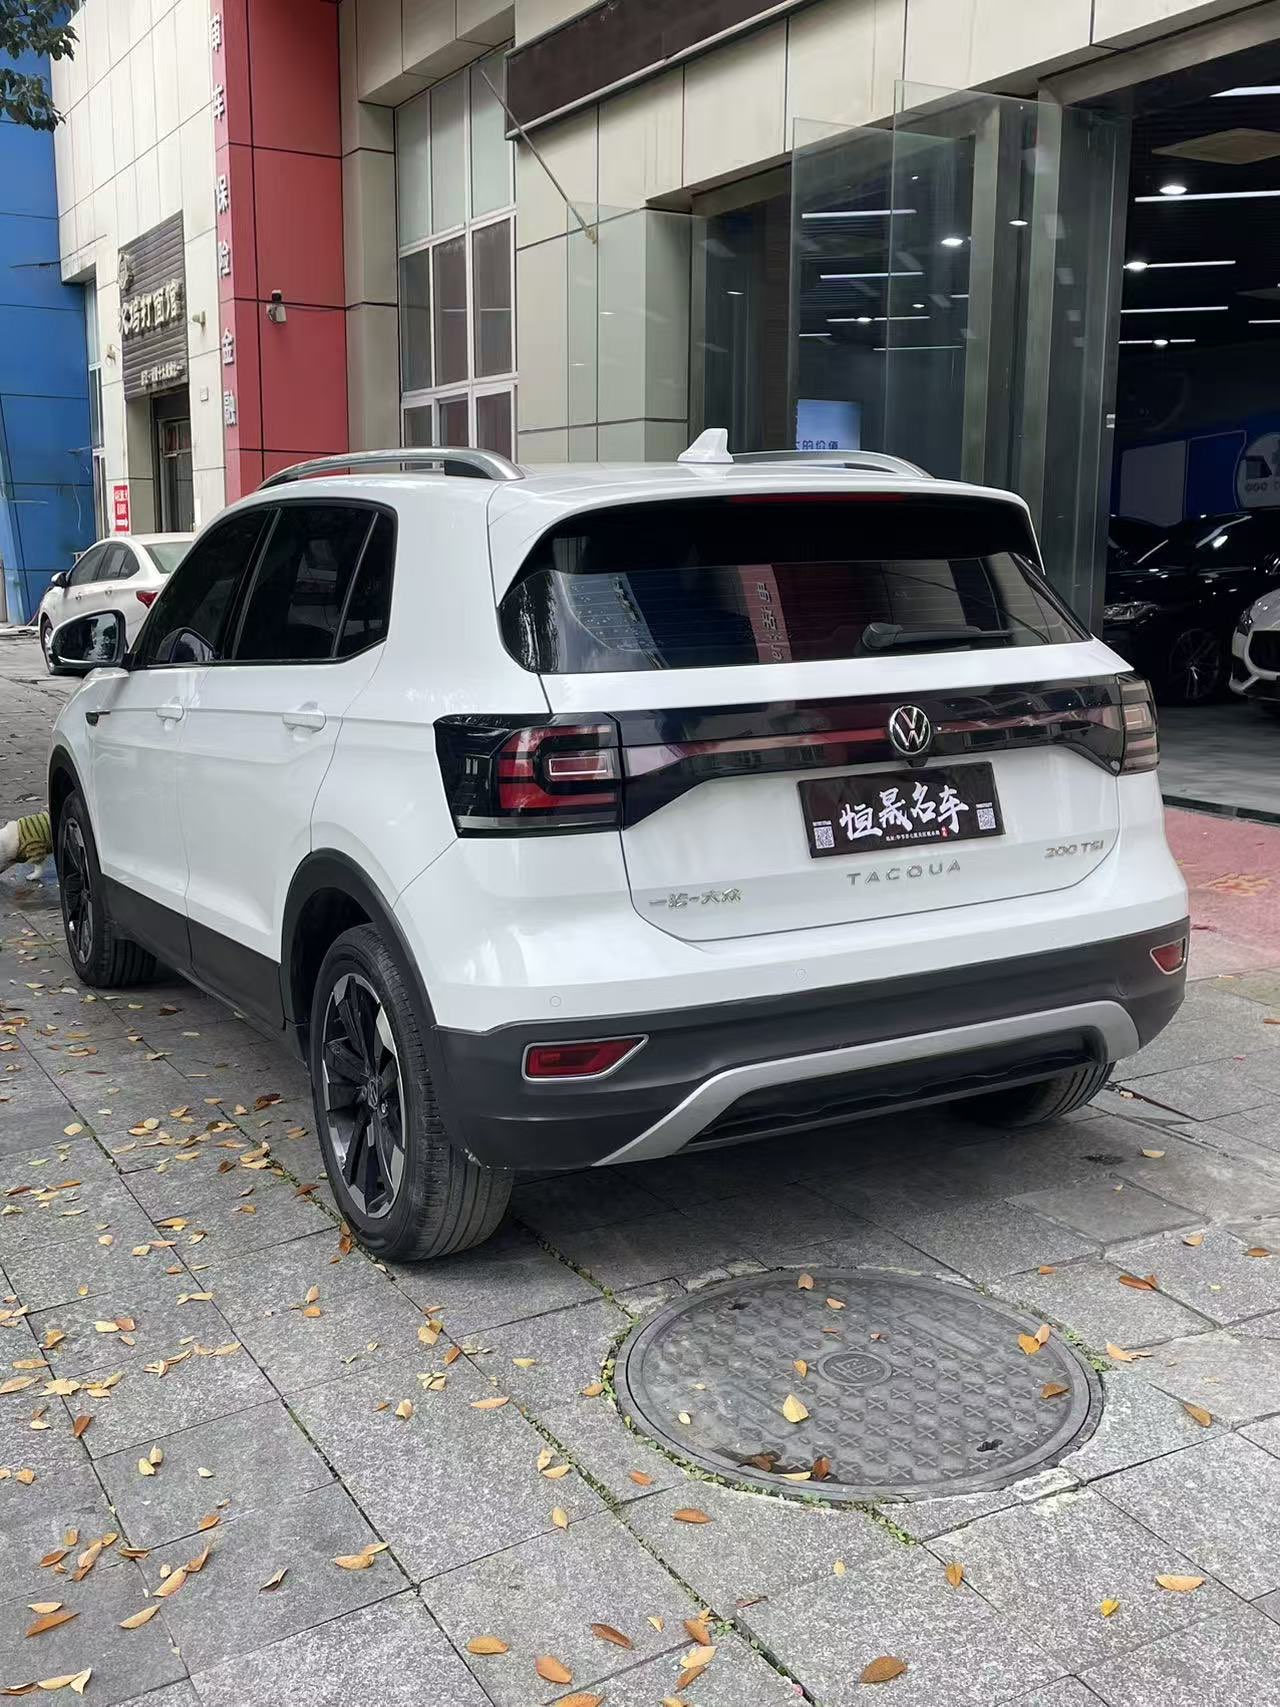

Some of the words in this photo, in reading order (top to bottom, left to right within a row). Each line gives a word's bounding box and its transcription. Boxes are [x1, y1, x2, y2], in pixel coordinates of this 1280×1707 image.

[839, 781, 970, 841] 恒晟名车
[1044, 844, 1078, 859] 200
[1080, 839, 1104, 854] TSI
